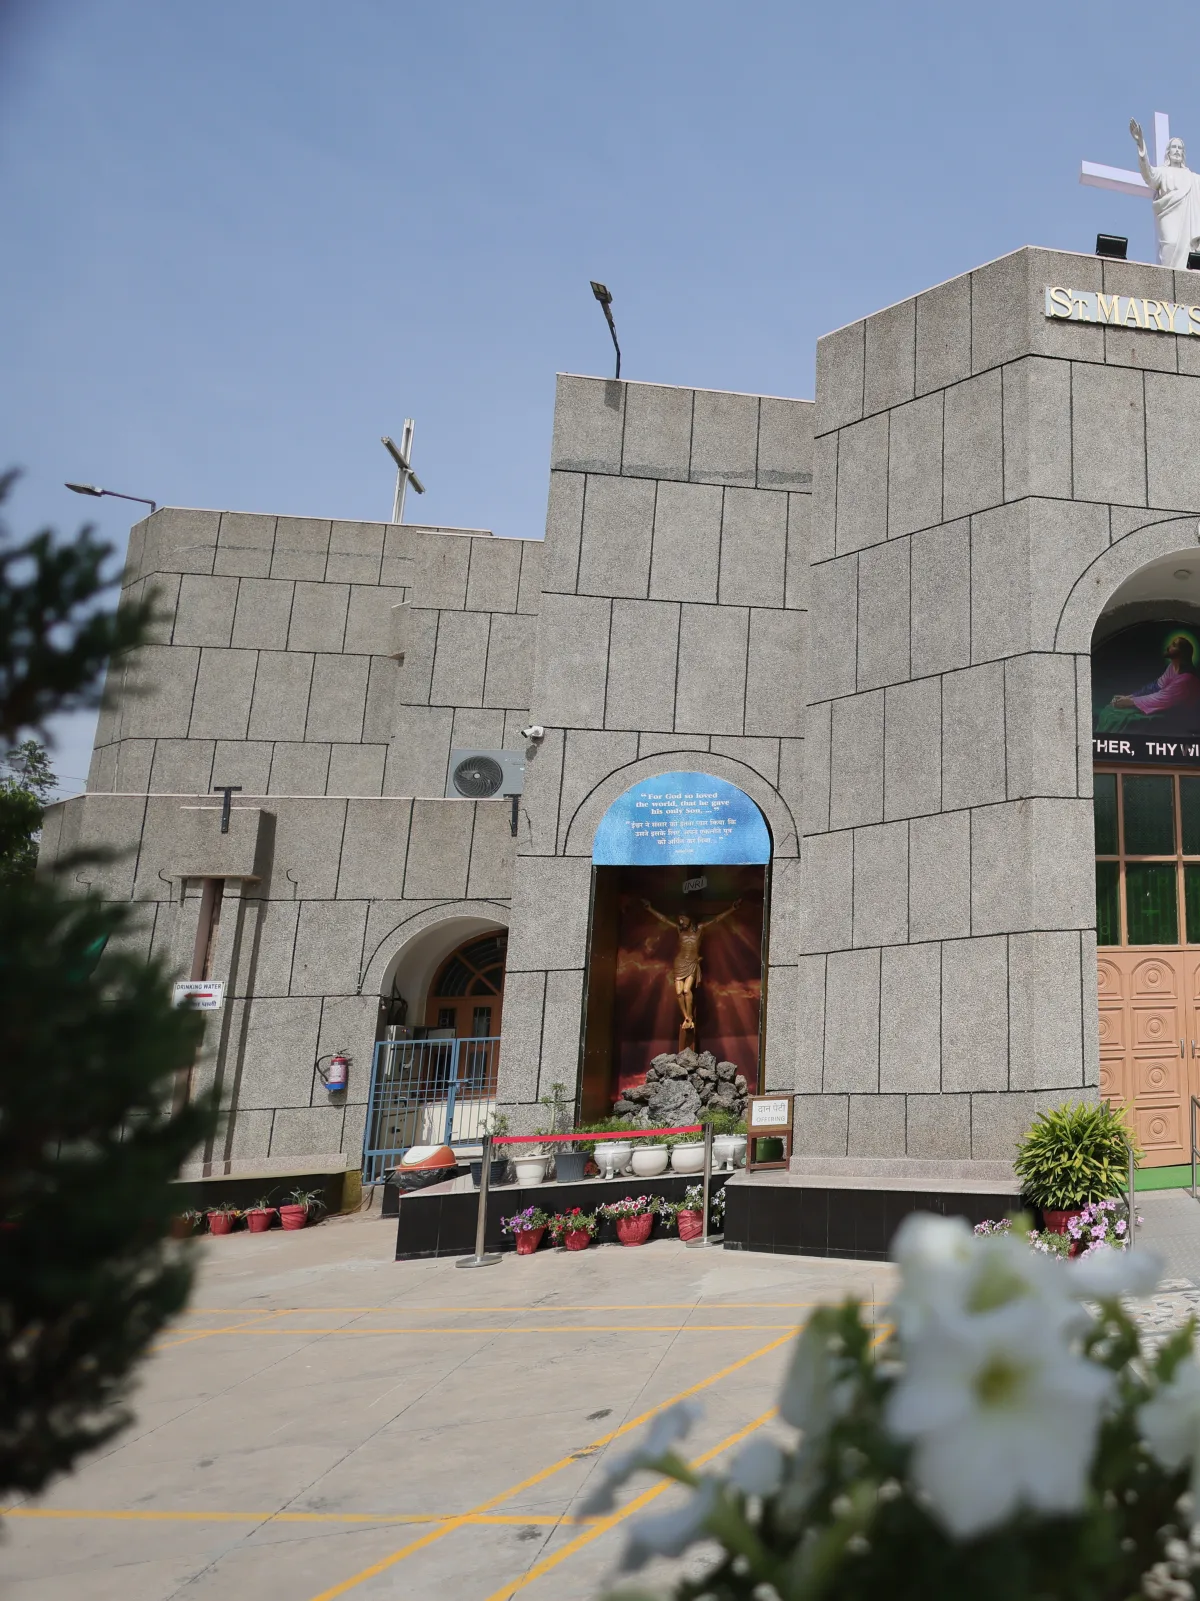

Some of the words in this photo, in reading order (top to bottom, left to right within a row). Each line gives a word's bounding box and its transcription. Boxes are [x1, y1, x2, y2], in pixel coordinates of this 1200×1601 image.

[1145, 742, 1178, 756] THY
[684, 879, 704, 891] INRI
[772, 1102, 786, 1112] पेटी
